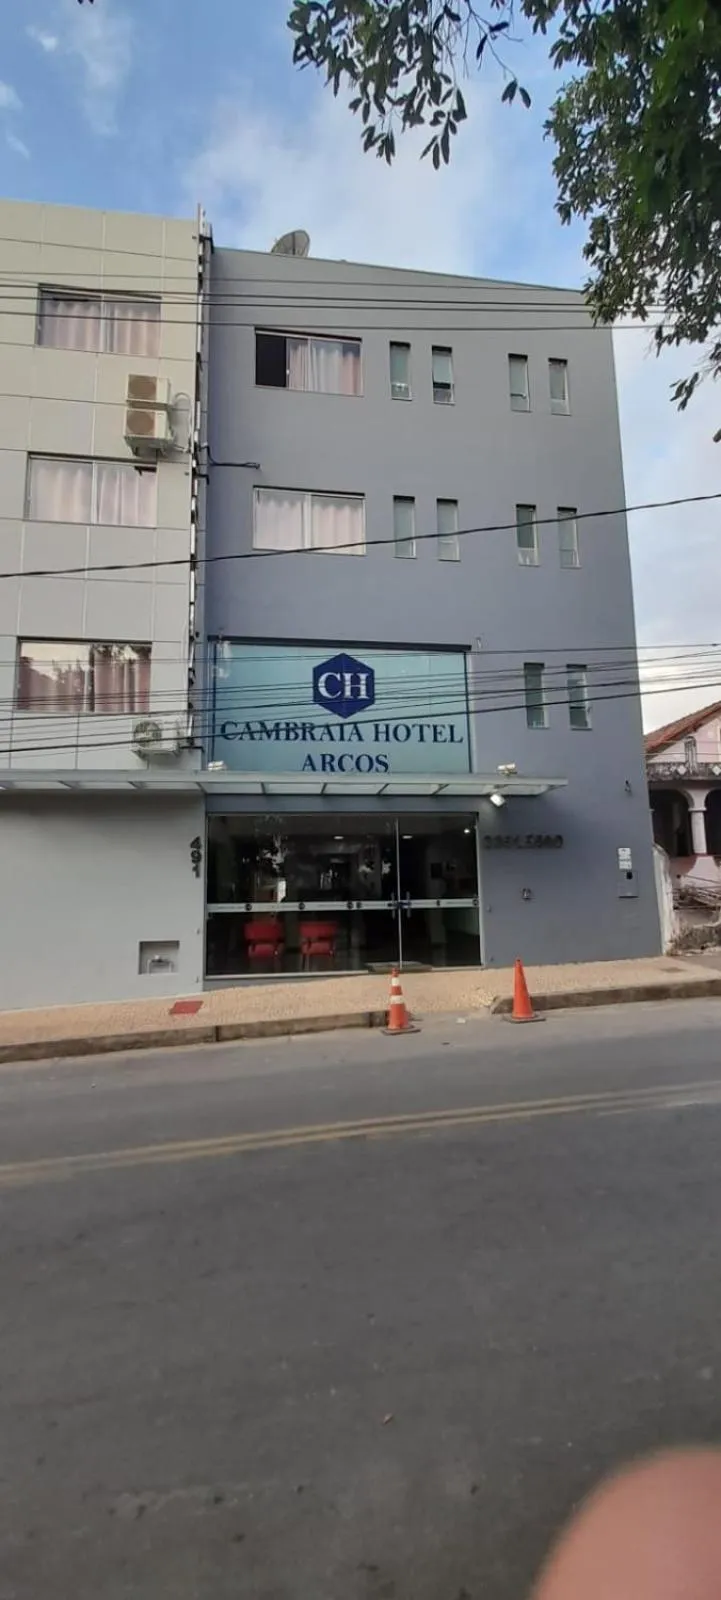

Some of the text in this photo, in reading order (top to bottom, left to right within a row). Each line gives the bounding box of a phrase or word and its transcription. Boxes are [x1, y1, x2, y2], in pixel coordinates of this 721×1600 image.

[318, 671, 369, 699] CH
[220, 721, 464, 743] CAMBRAIA HOTEL
[302, 753, 389, 772] ARCOS
[190, 836, 202, 878] 491
